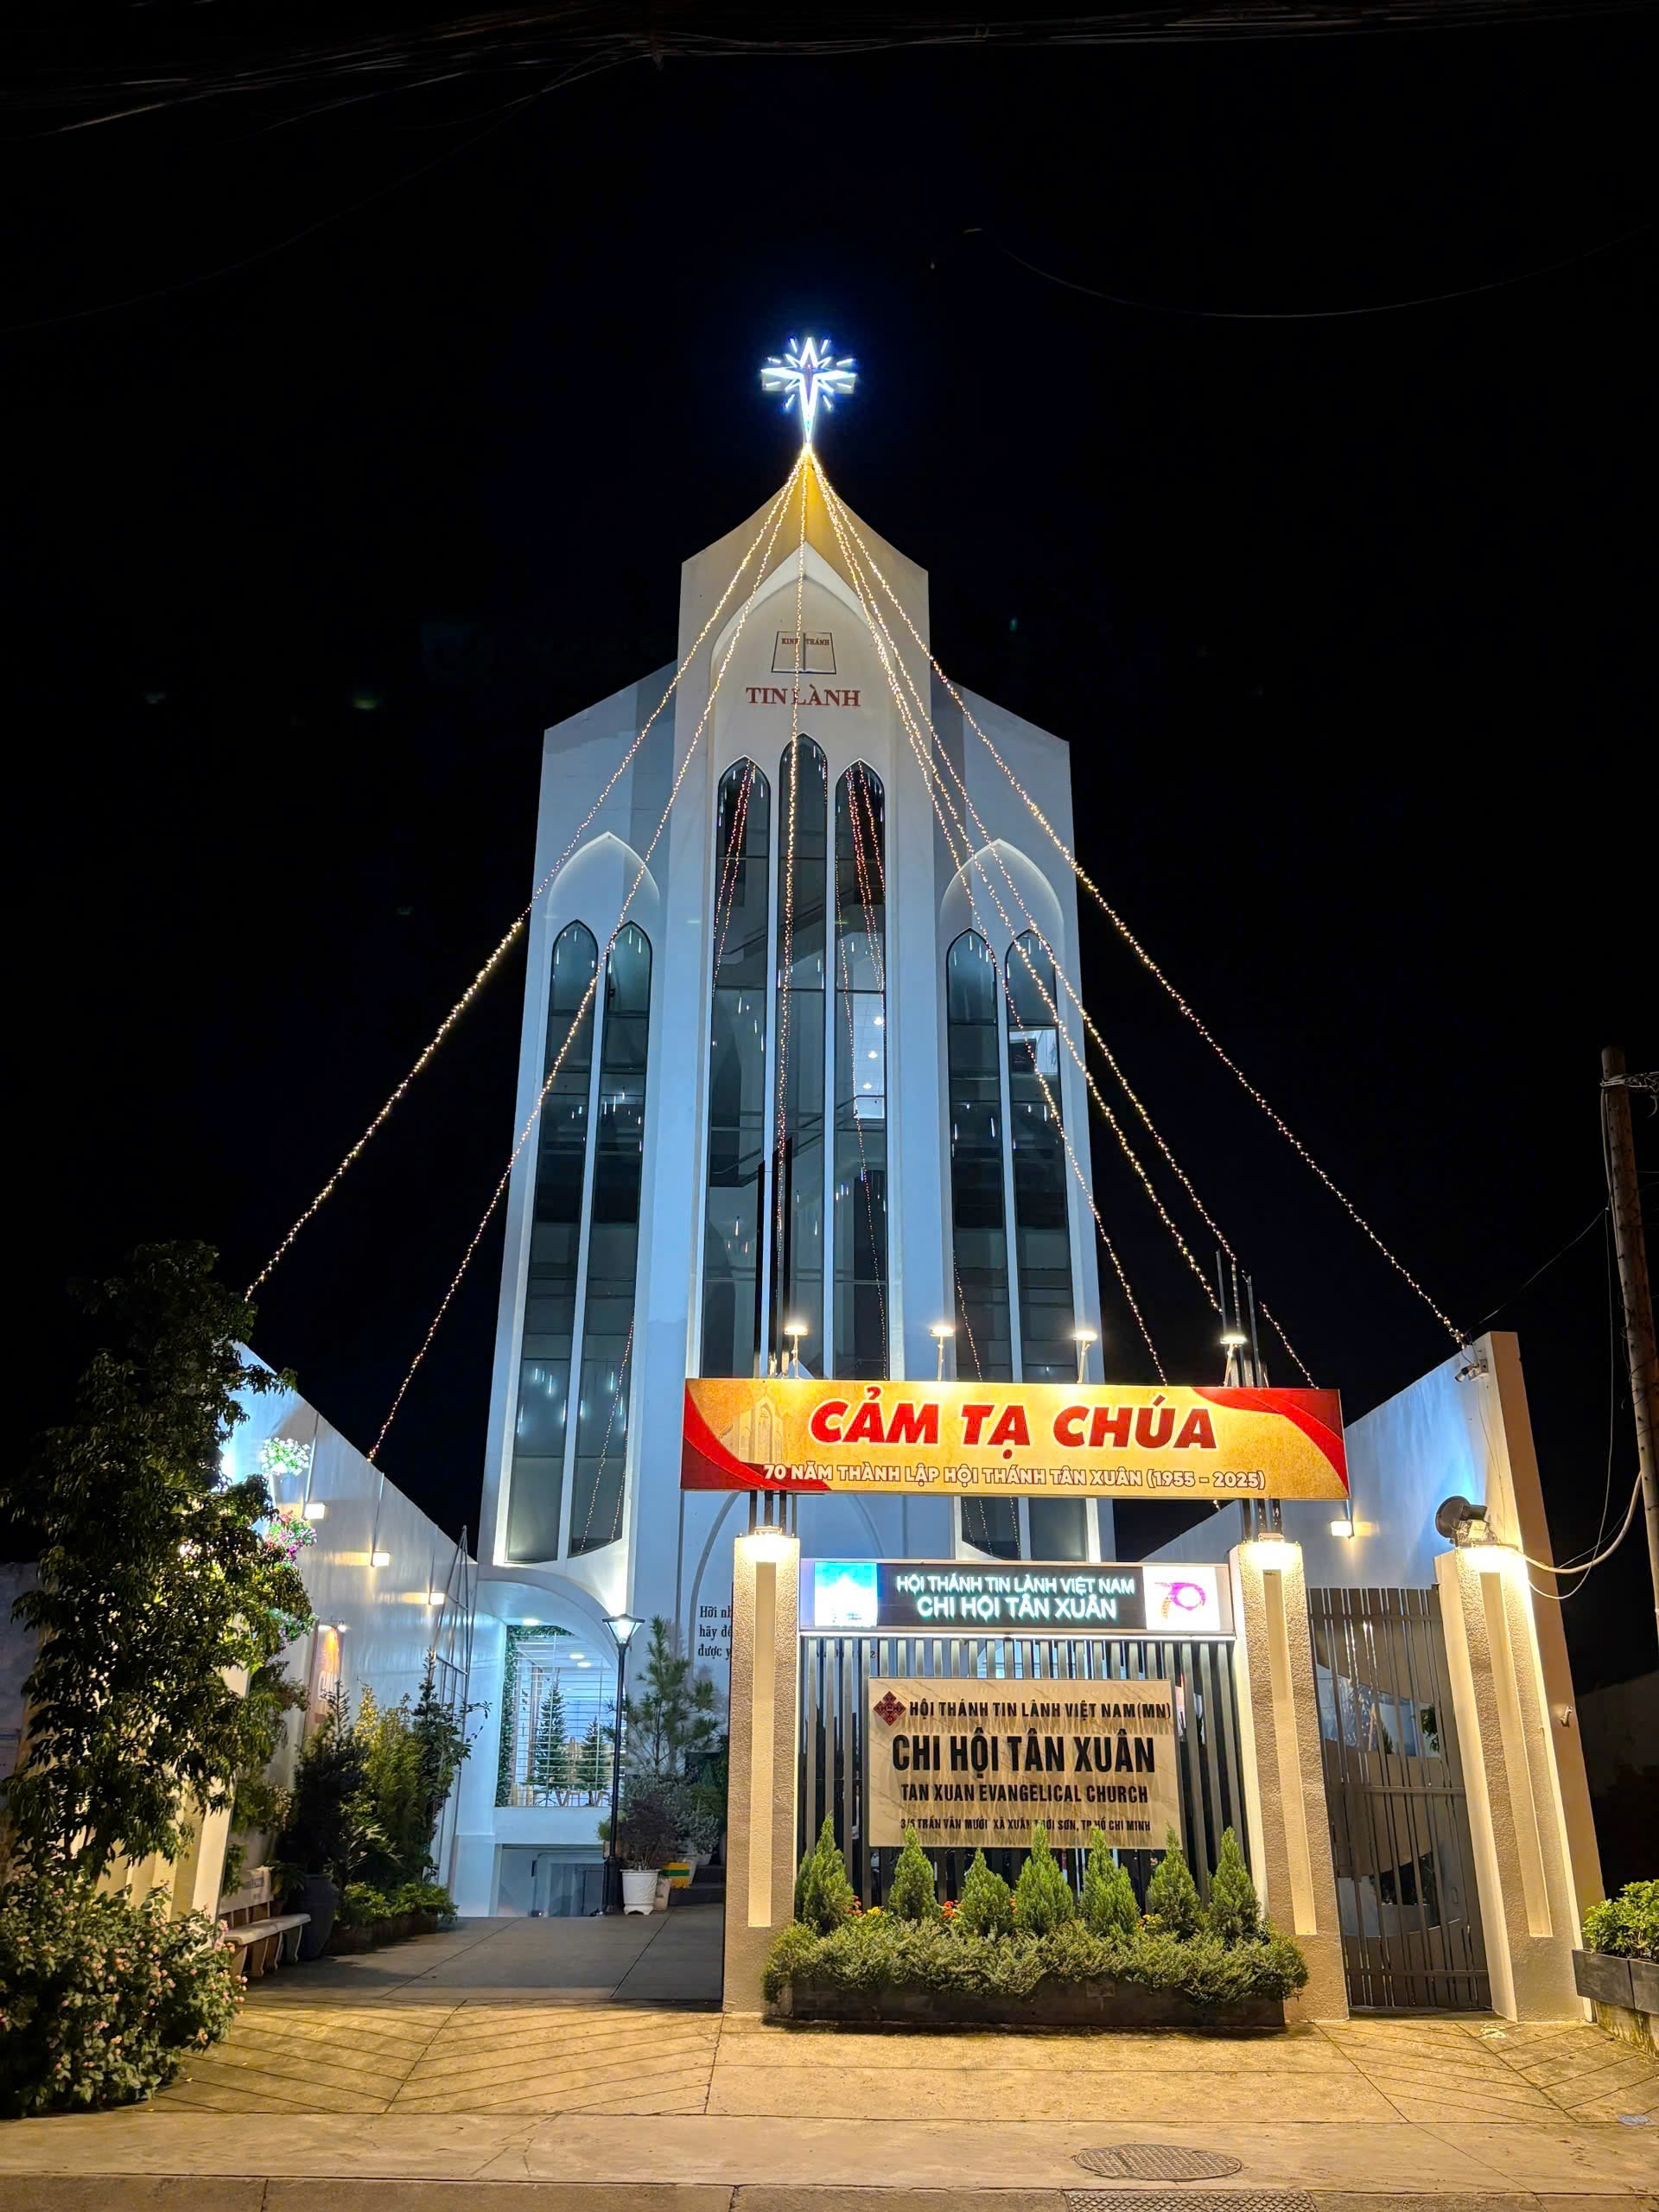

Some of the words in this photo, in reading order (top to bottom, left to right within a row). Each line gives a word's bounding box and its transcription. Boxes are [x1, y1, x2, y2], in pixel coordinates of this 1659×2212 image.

[746, 687, 788, 704] TIN
[791, 683, 861, 707] LÀNH
[810, 1386, 938, 1444] CẢM
[962, 1403, 1031, 1459] TẠ
[1053, 1395, 1217, 1449] CHÚA
[764, 1464, 786, 1480] 70
[791, 1461, 833, 1480] NĂM
[836, 1462, 901, 1483] THÀNH
[906, 1463, 940, 1487] LẬP
[944, 1464, 979, 1488] HỘI
[982, 1464, 1046, 1485] THÁNH
[1050, 1465, 1087, 1486] TÂN
[1090, 1466, 1143, 1487] XUÂN
[1147, 1468, 1196, 1488] (1955
[1198, 1476, 1210, 1484] -
[1212, 1470, 1266, 1490] 2025)
[896, 1573, 925, 1594] HỘI
[927, 1573, 982, 1593] THÁNH
[984, 1576, 1011, 1593] TIN
[1014, 1573, 1058, 1594] LÀNH
[1059, 1576, 1096, 1596] VIỆT
[1098, 1578, 1135, 1594] NAM
[917, 1596, 955, 1618] CHI
[961, 1595, 1000, 1622] HỘI
[1004, 1592, 1050, 1619] TÂN
[1054, 1593, 1117, 1619] XUÂN
[698, 1624, 717, 1641] hãy
[697, 1643, 722, 1660] được
[910, 1698, 934, 1719] HỘI
[939, 1698, 988, 1716] THÁNH
[993, 1702, 1017, 1717] TIN
[1021, 1700, 1060, 1718] LÀNH
[1065, 1700, 1096, 1720] VIỆT
[893, 1734, 940, 1771] CHI
[950, 1726, 999, 1779] HỘI
[1007, 1728, 1065, 1772] TÂN
[1073, 1728, 1155, 1773] XUÂN
[901, 1784, 929, 1801] TAN
[933, 1784, 975, 1802] XUAN
[979, 1784, 1082, 1802] EVANGELICAL
[1086, 1785, 1148, 1803] CHURCH
[1109, 1820, 1124, 1831] CHI
[1127, 1820, 1151, 1832] MINH
